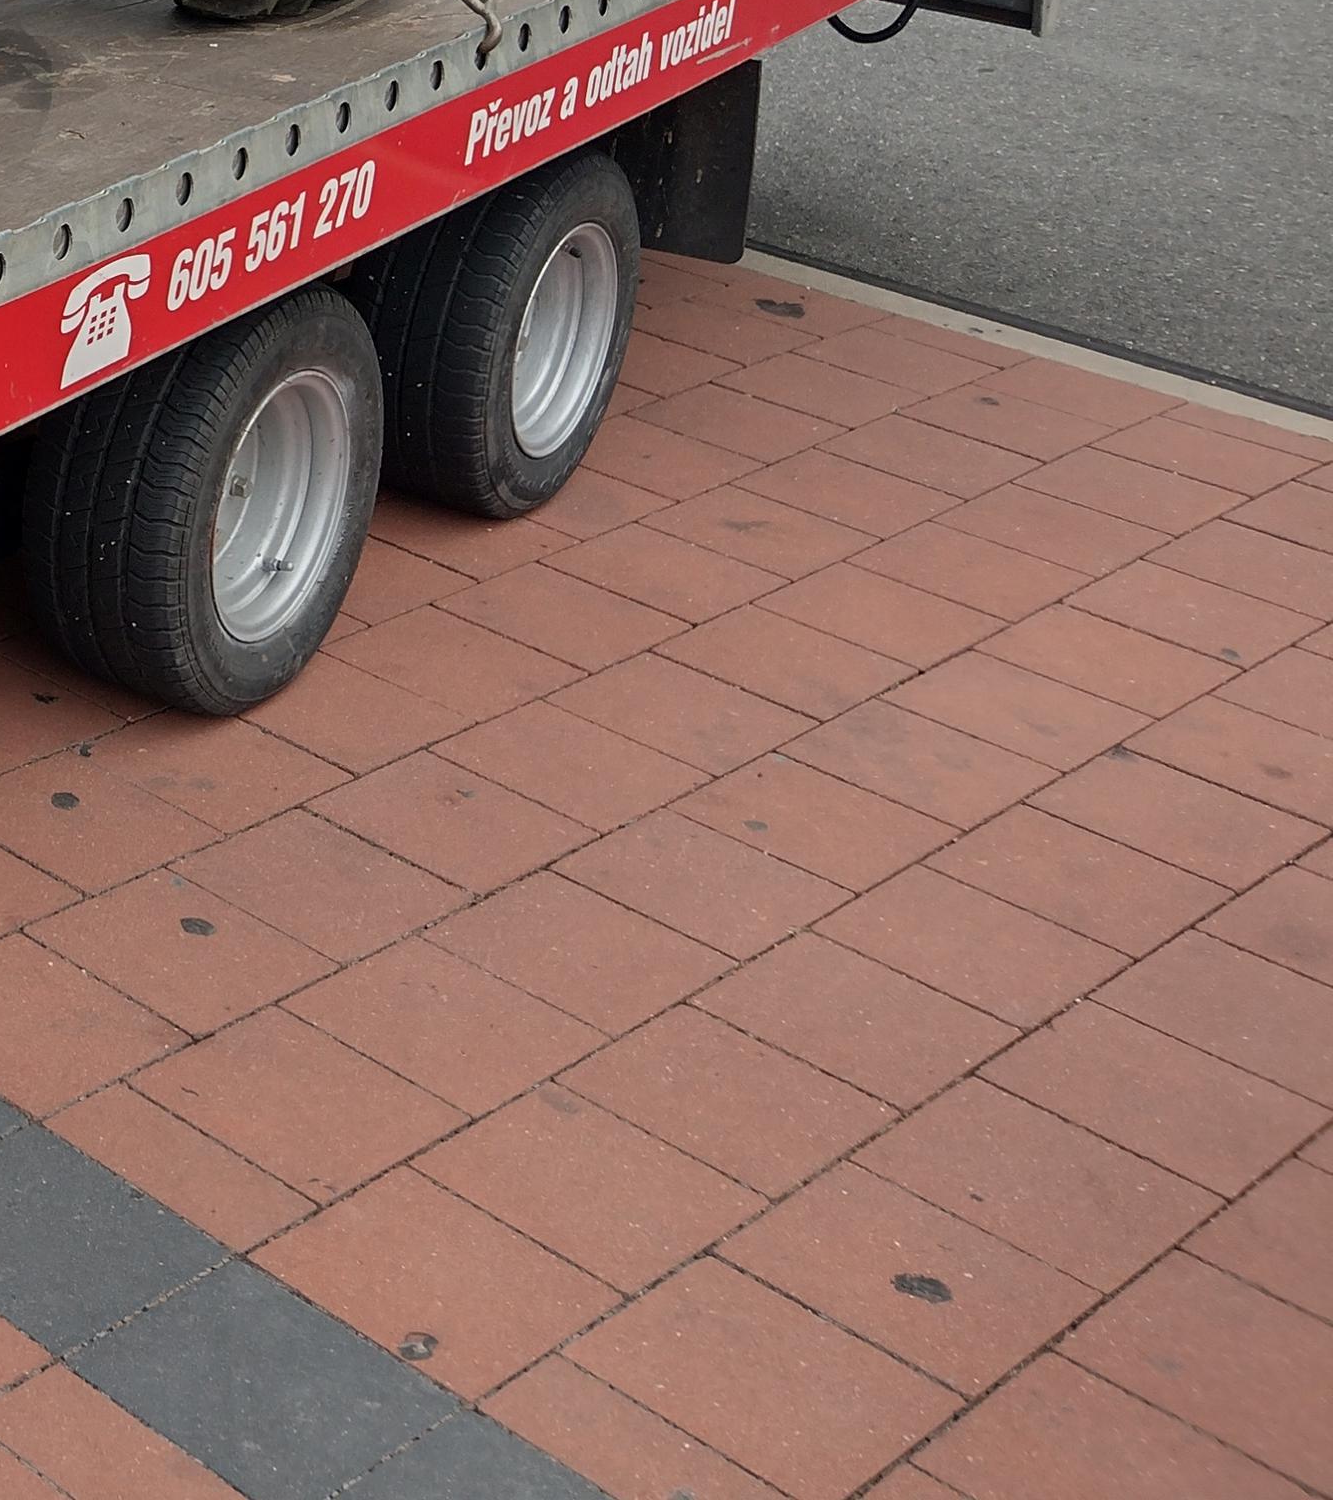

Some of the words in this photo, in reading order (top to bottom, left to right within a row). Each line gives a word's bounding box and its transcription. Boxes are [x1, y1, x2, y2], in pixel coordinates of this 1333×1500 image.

[464, 97, 545, 166] Převoz
[559, 76, 579, 121] a
[584, 32, 652, 108] odtah
[166, 248, 234, 313] 605
[245, 201, 303, 274] 561
[313, 160, 376, 239] 270
